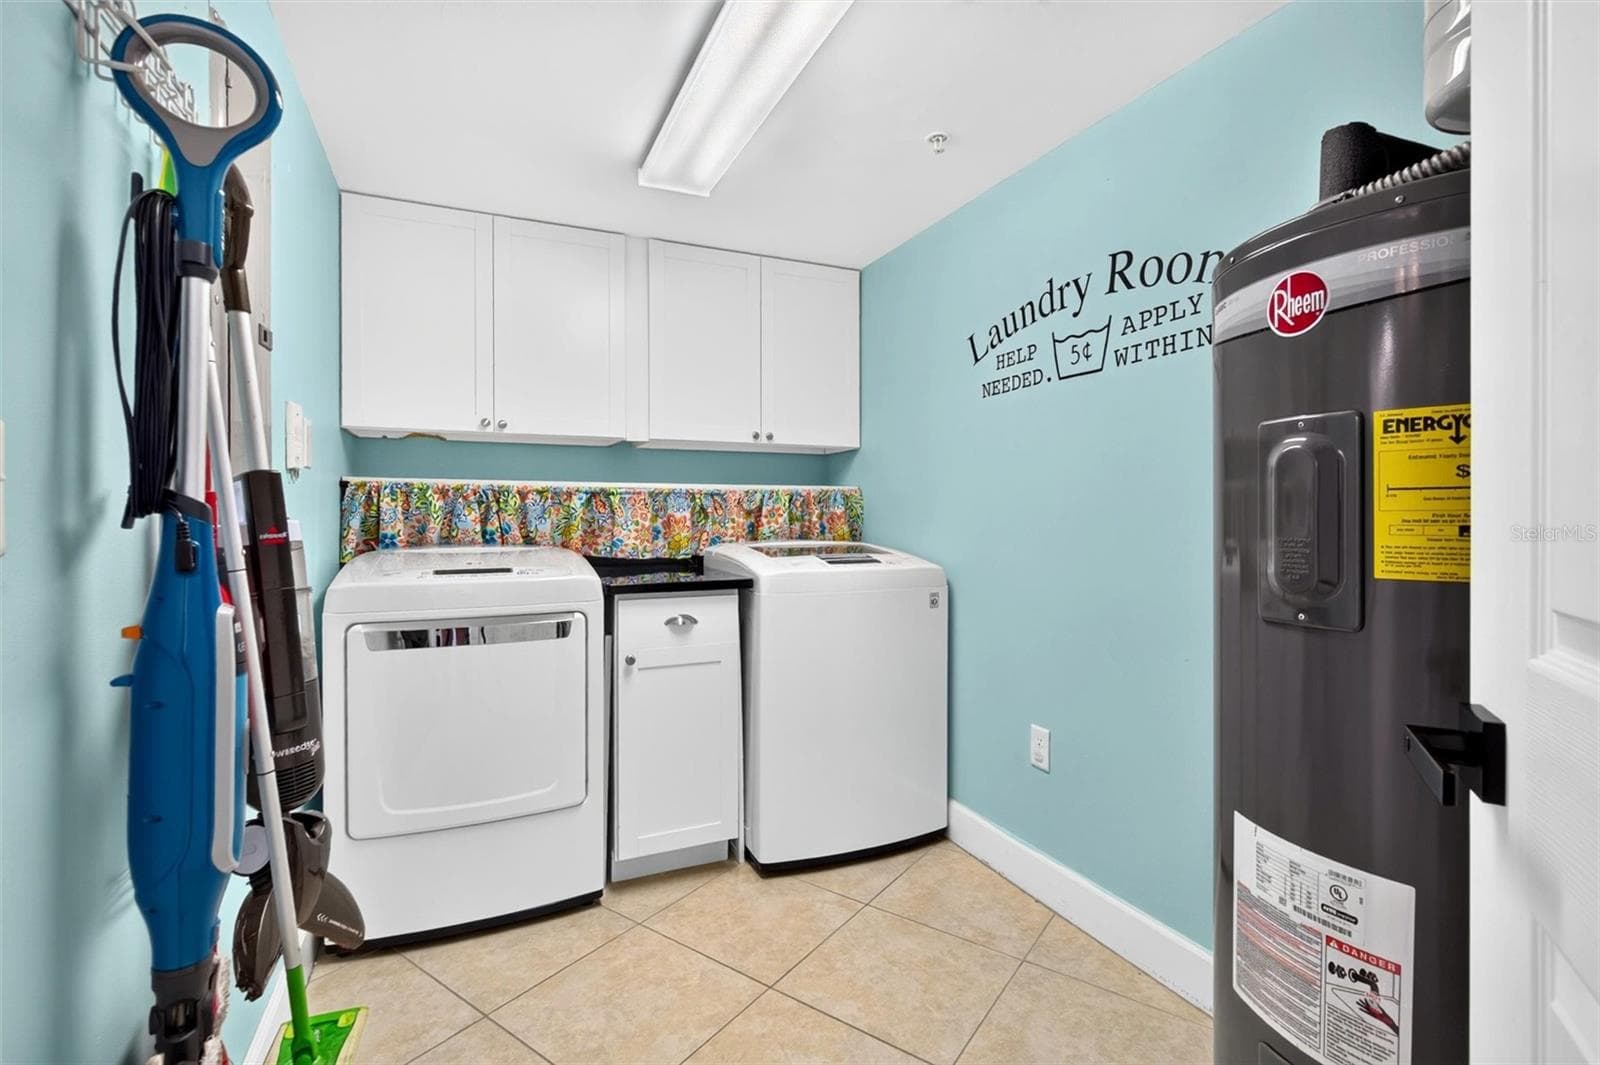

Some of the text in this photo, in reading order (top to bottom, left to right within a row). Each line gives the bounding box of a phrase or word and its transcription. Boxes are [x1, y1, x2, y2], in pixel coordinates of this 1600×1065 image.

[967, 272, 1092, 366] Laundry
[1121, 293, 1204, 336] APPLY
[1274, 276, 1324, 329] Rheem
[995, 344, 1037, 371] HELP
[1070, 341, 1092, 365] 5¢
[1114, 324, 1213, 367] WITHIN
[981, 369, 1051, 398] NEEDED.
[1342, 944, 1396, 972] DANGER
